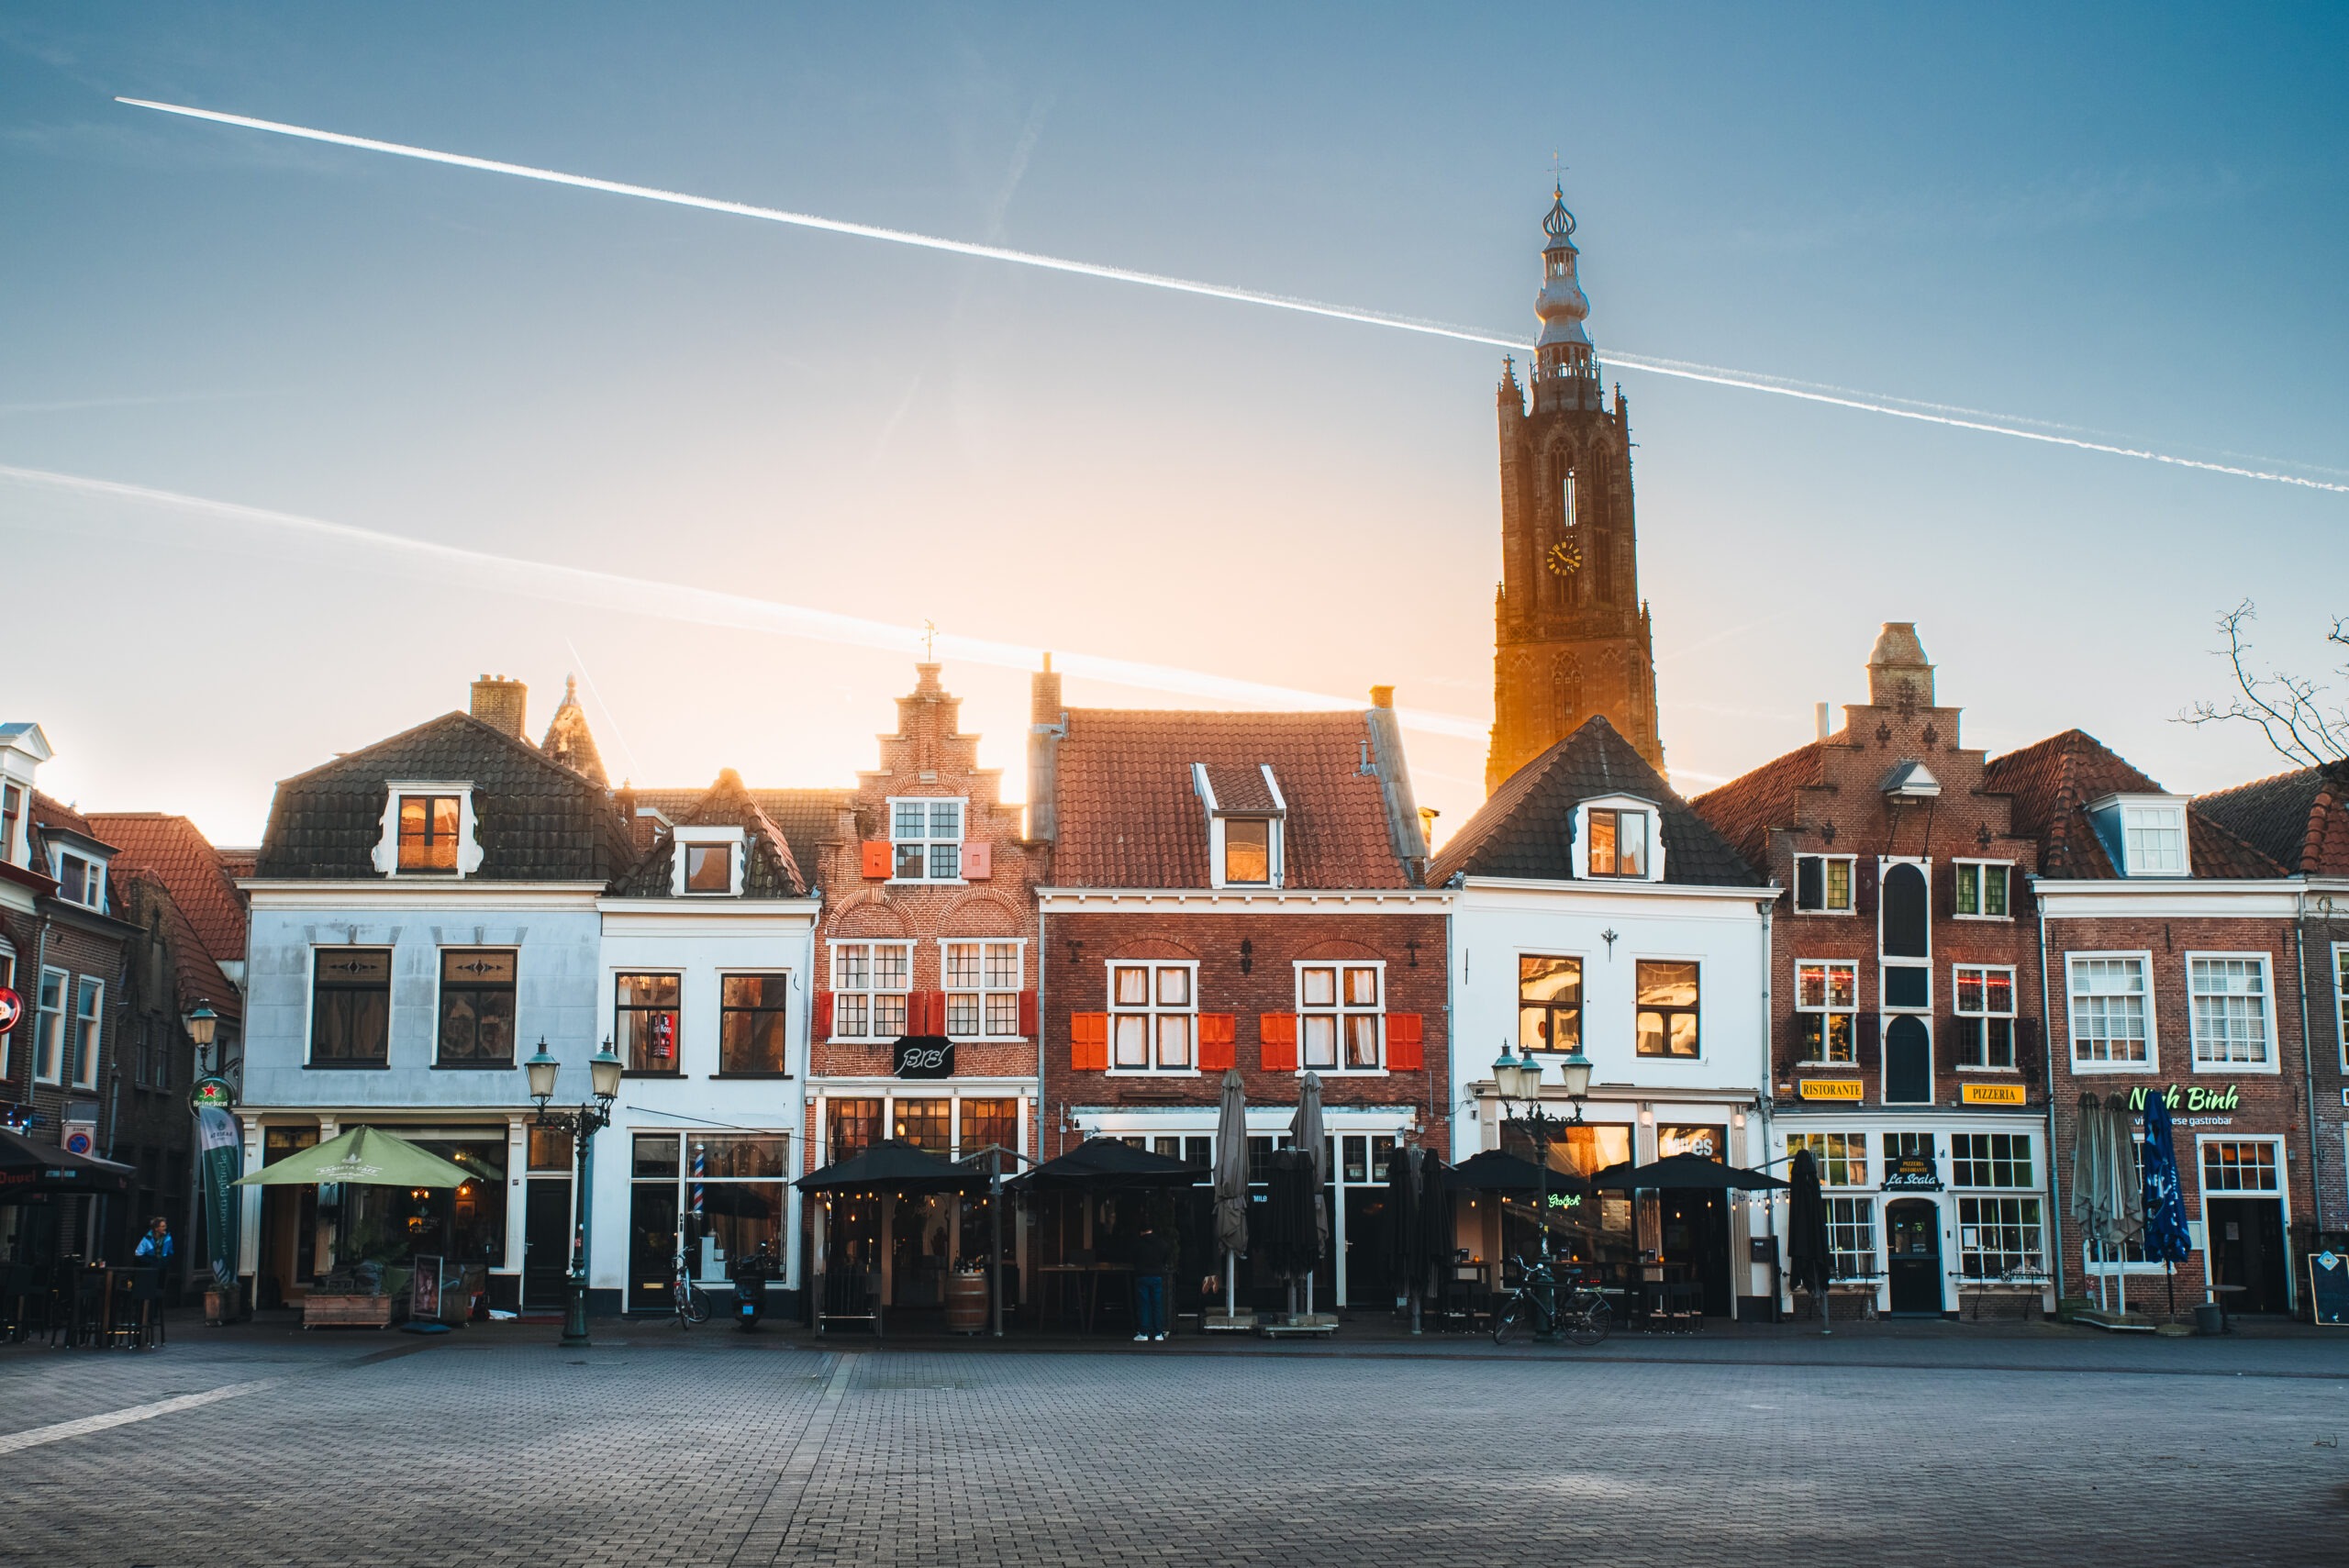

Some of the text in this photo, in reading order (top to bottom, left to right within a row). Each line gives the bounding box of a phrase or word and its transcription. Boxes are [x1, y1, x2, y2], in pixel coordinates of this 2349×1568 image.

[1803, 1084, 1862, 1095] RISTORANTE
[1973, 1088, 2016, 1100] PIZZERIA
[2129, 1084, 2239, 1110] Nh Binh
[2188, 1116, 2232, 1127] gastrobar
[1886, 1173, 1936, 1185] La Scala
[1548, 1194, 1581, 1208] Grolsch
